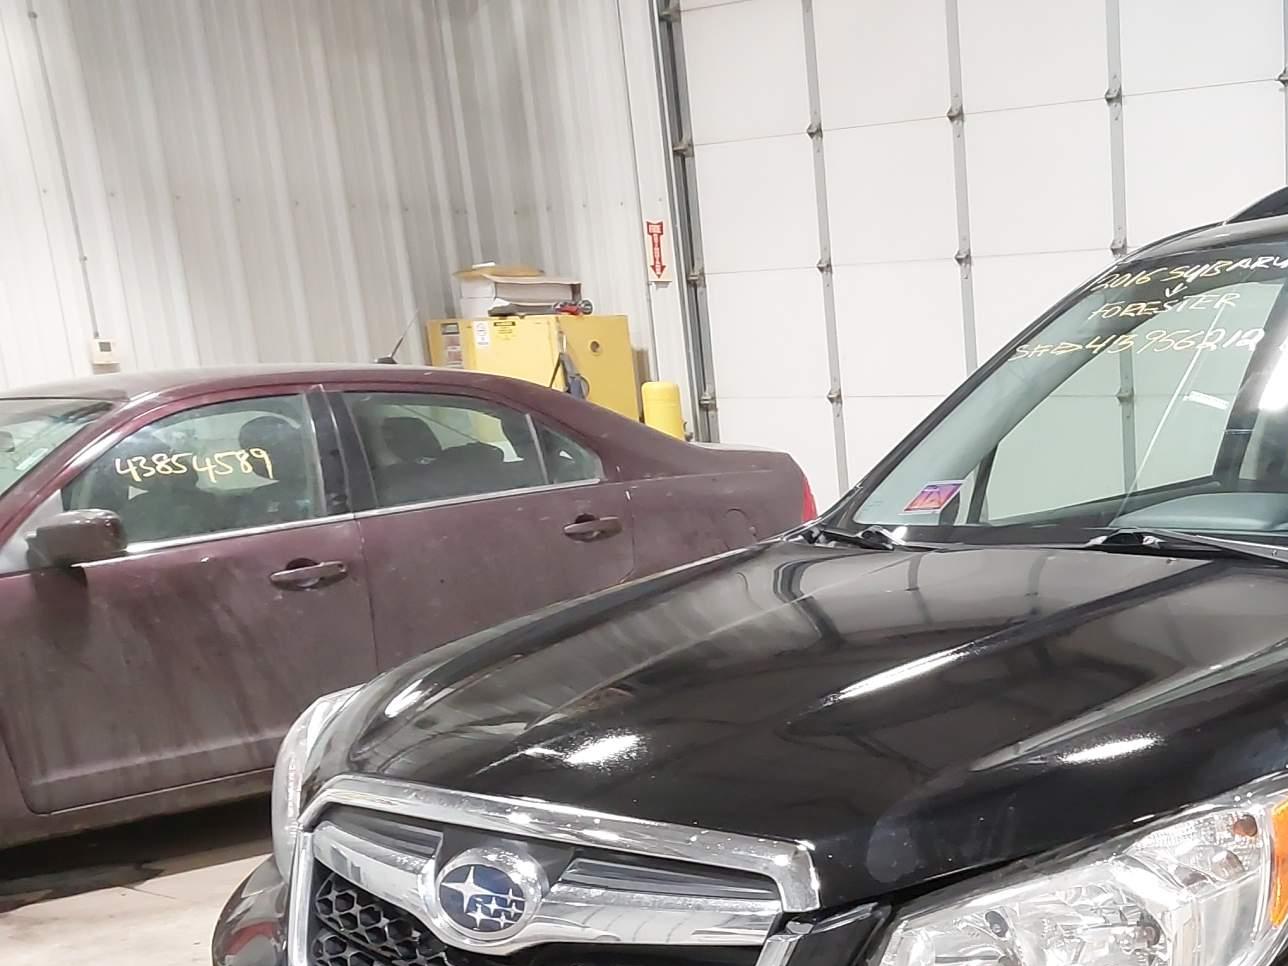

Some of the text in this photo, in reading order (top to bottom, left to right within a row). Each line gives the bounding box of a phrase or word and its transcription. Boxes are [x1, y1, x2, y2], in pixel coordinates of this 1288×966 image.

[1091, 268, 1168, 292] 2016
[1088, 293, 1241, 321] FORESTER
[115, 448, 274, 483] 43854589
